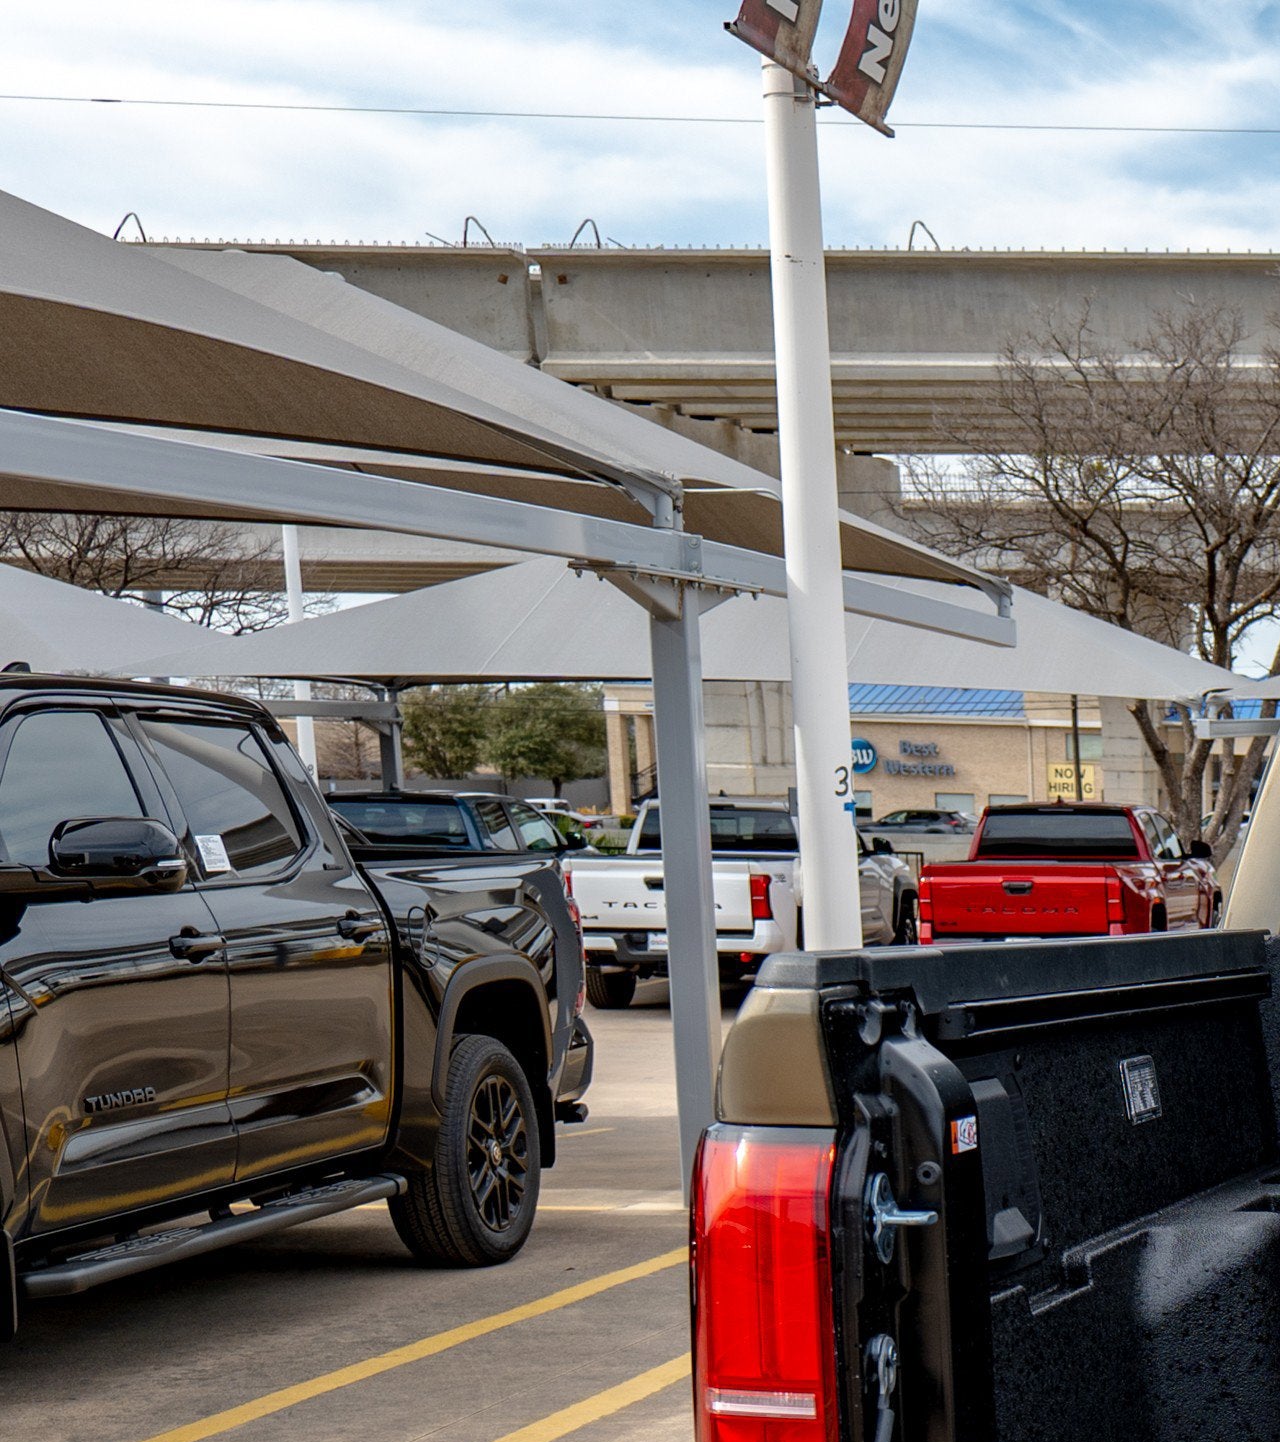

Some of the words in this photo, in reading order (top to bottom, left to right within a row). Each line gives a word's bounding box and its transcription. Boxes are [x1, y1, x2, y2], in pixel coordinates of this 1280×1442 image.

[899, 740, 939, 757] Best
[883, 760, 956, 777] Western
[834, 766, 849, 797] 3
[1048, 782, 1093, 793] HIRIG
[602, 901, 722, 909] TACA
[84, 1086, 156, 1113] TUNDRA
